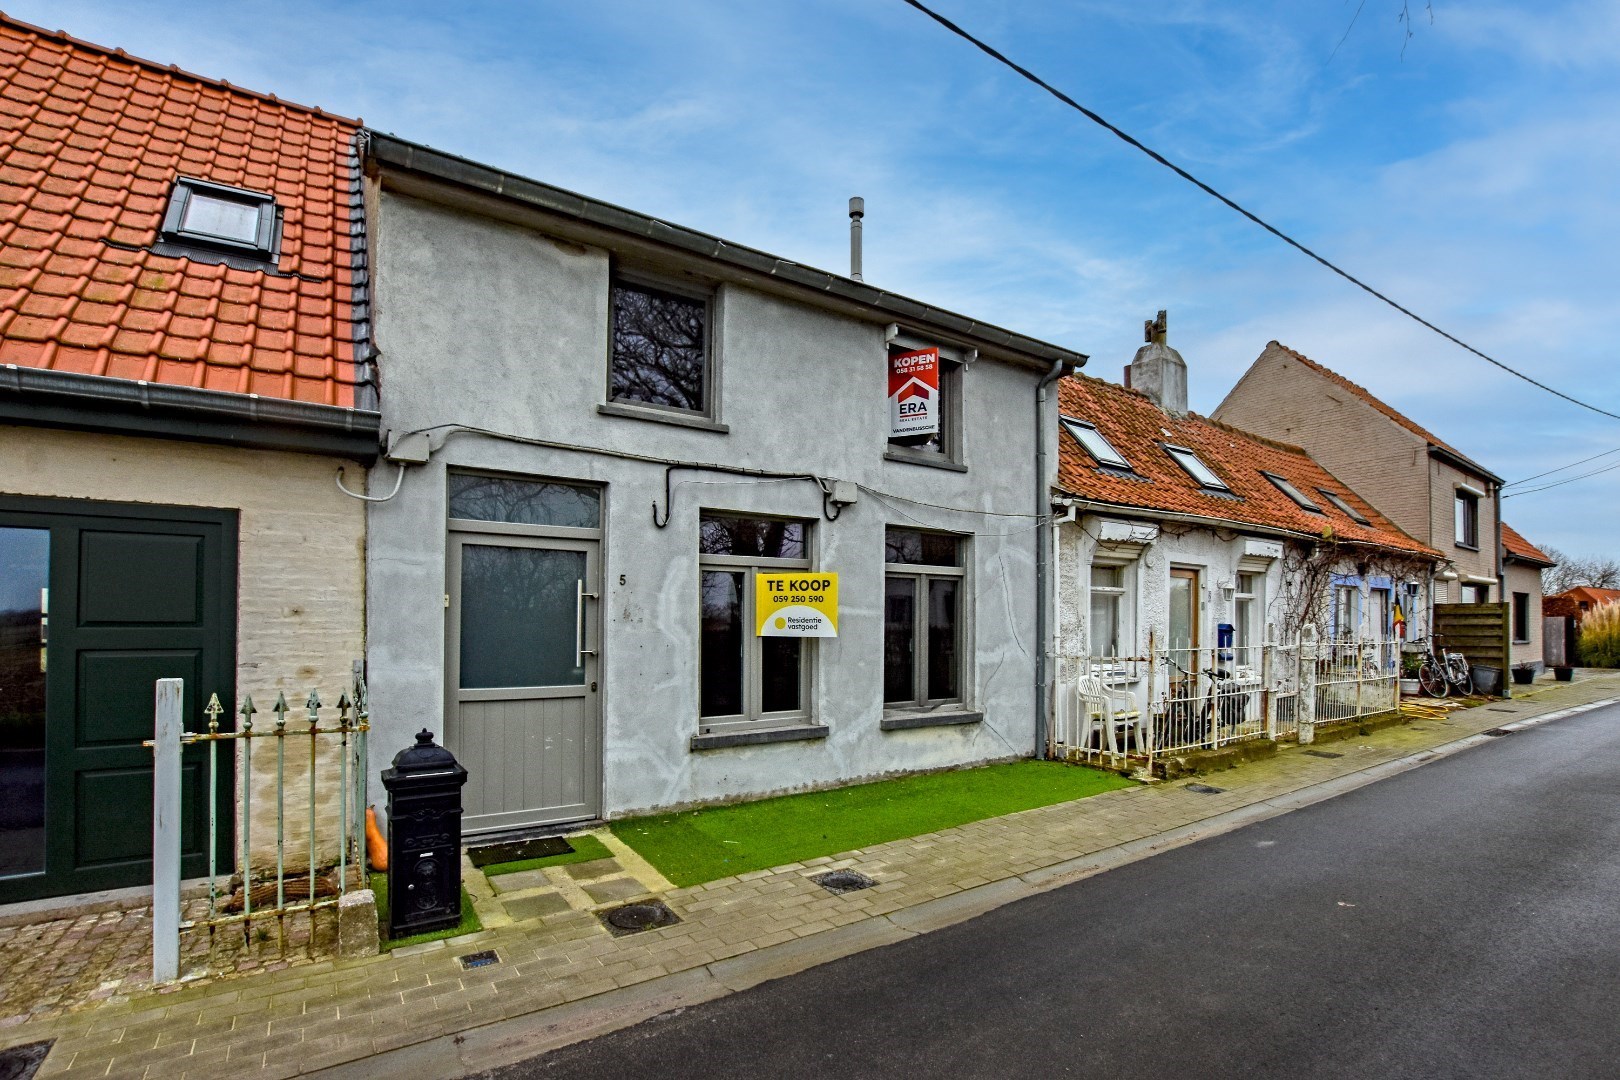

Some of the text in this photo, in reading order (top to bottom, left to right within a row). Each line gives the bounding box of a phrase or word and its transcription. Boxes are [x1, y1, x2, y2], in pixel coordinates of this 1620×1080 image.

[894, 353, 935, 368] KOPEN
[899, 402, 927, 414] ERA
[893, 425, 935, 433] VANDENBUSSCHE
[619, 574, 626, 586] 5
[767, 580, 831, 591] TE KOOP
[773, 595, 824, 603] 059 250 590
[787, 616, 822, 624] Residentie
[787, 623, 818, 631] vastgoed
